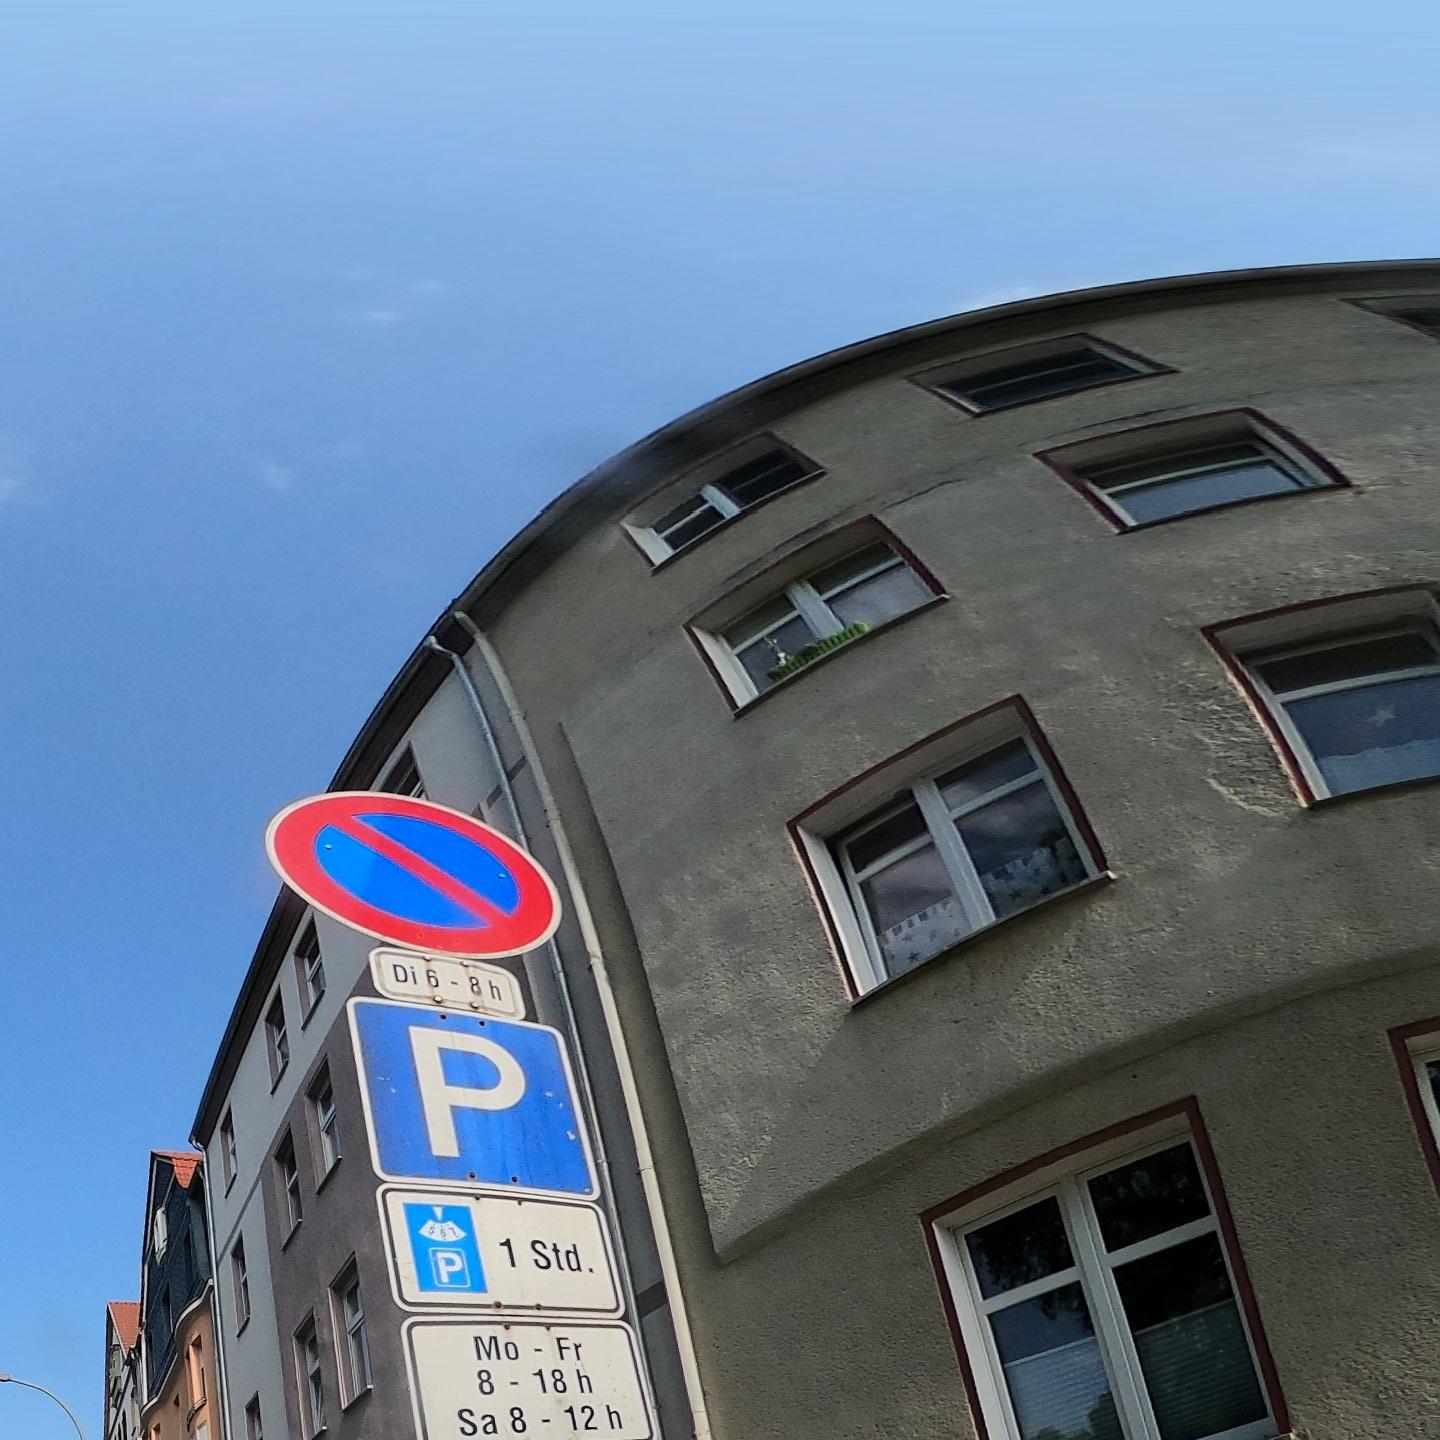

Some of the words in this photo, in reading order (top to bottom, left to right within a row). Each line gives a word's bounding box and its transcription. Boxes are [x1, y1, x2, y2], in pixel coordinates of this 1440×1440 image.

[392, 964, 417, 985] Di
[425, 969, 439, 988] 6
[470, 976, 482, 995] 8
[488, 980, 503, 1001] h
[408, 1025, 526, 1157] P
[436, 1252, 464, 1284] P
[499, 1238, 516, 1268] 1
[530, 1240, 595, 1274] Std.
[473, 1335, 519, 1361] Mo
[556, 1337, 583, 1361] Fr
[477, 1369, 495, 1395] 8
[532, 1368, 567, 1394] 18
[576, 1368, 593, 1394] h
[457, 1408, 498, 1437] Sa
[509, 1406, 527, 1434] 8
[564, 1405, 598, 1431] 12
[606, 1404, 624, 1430] h
